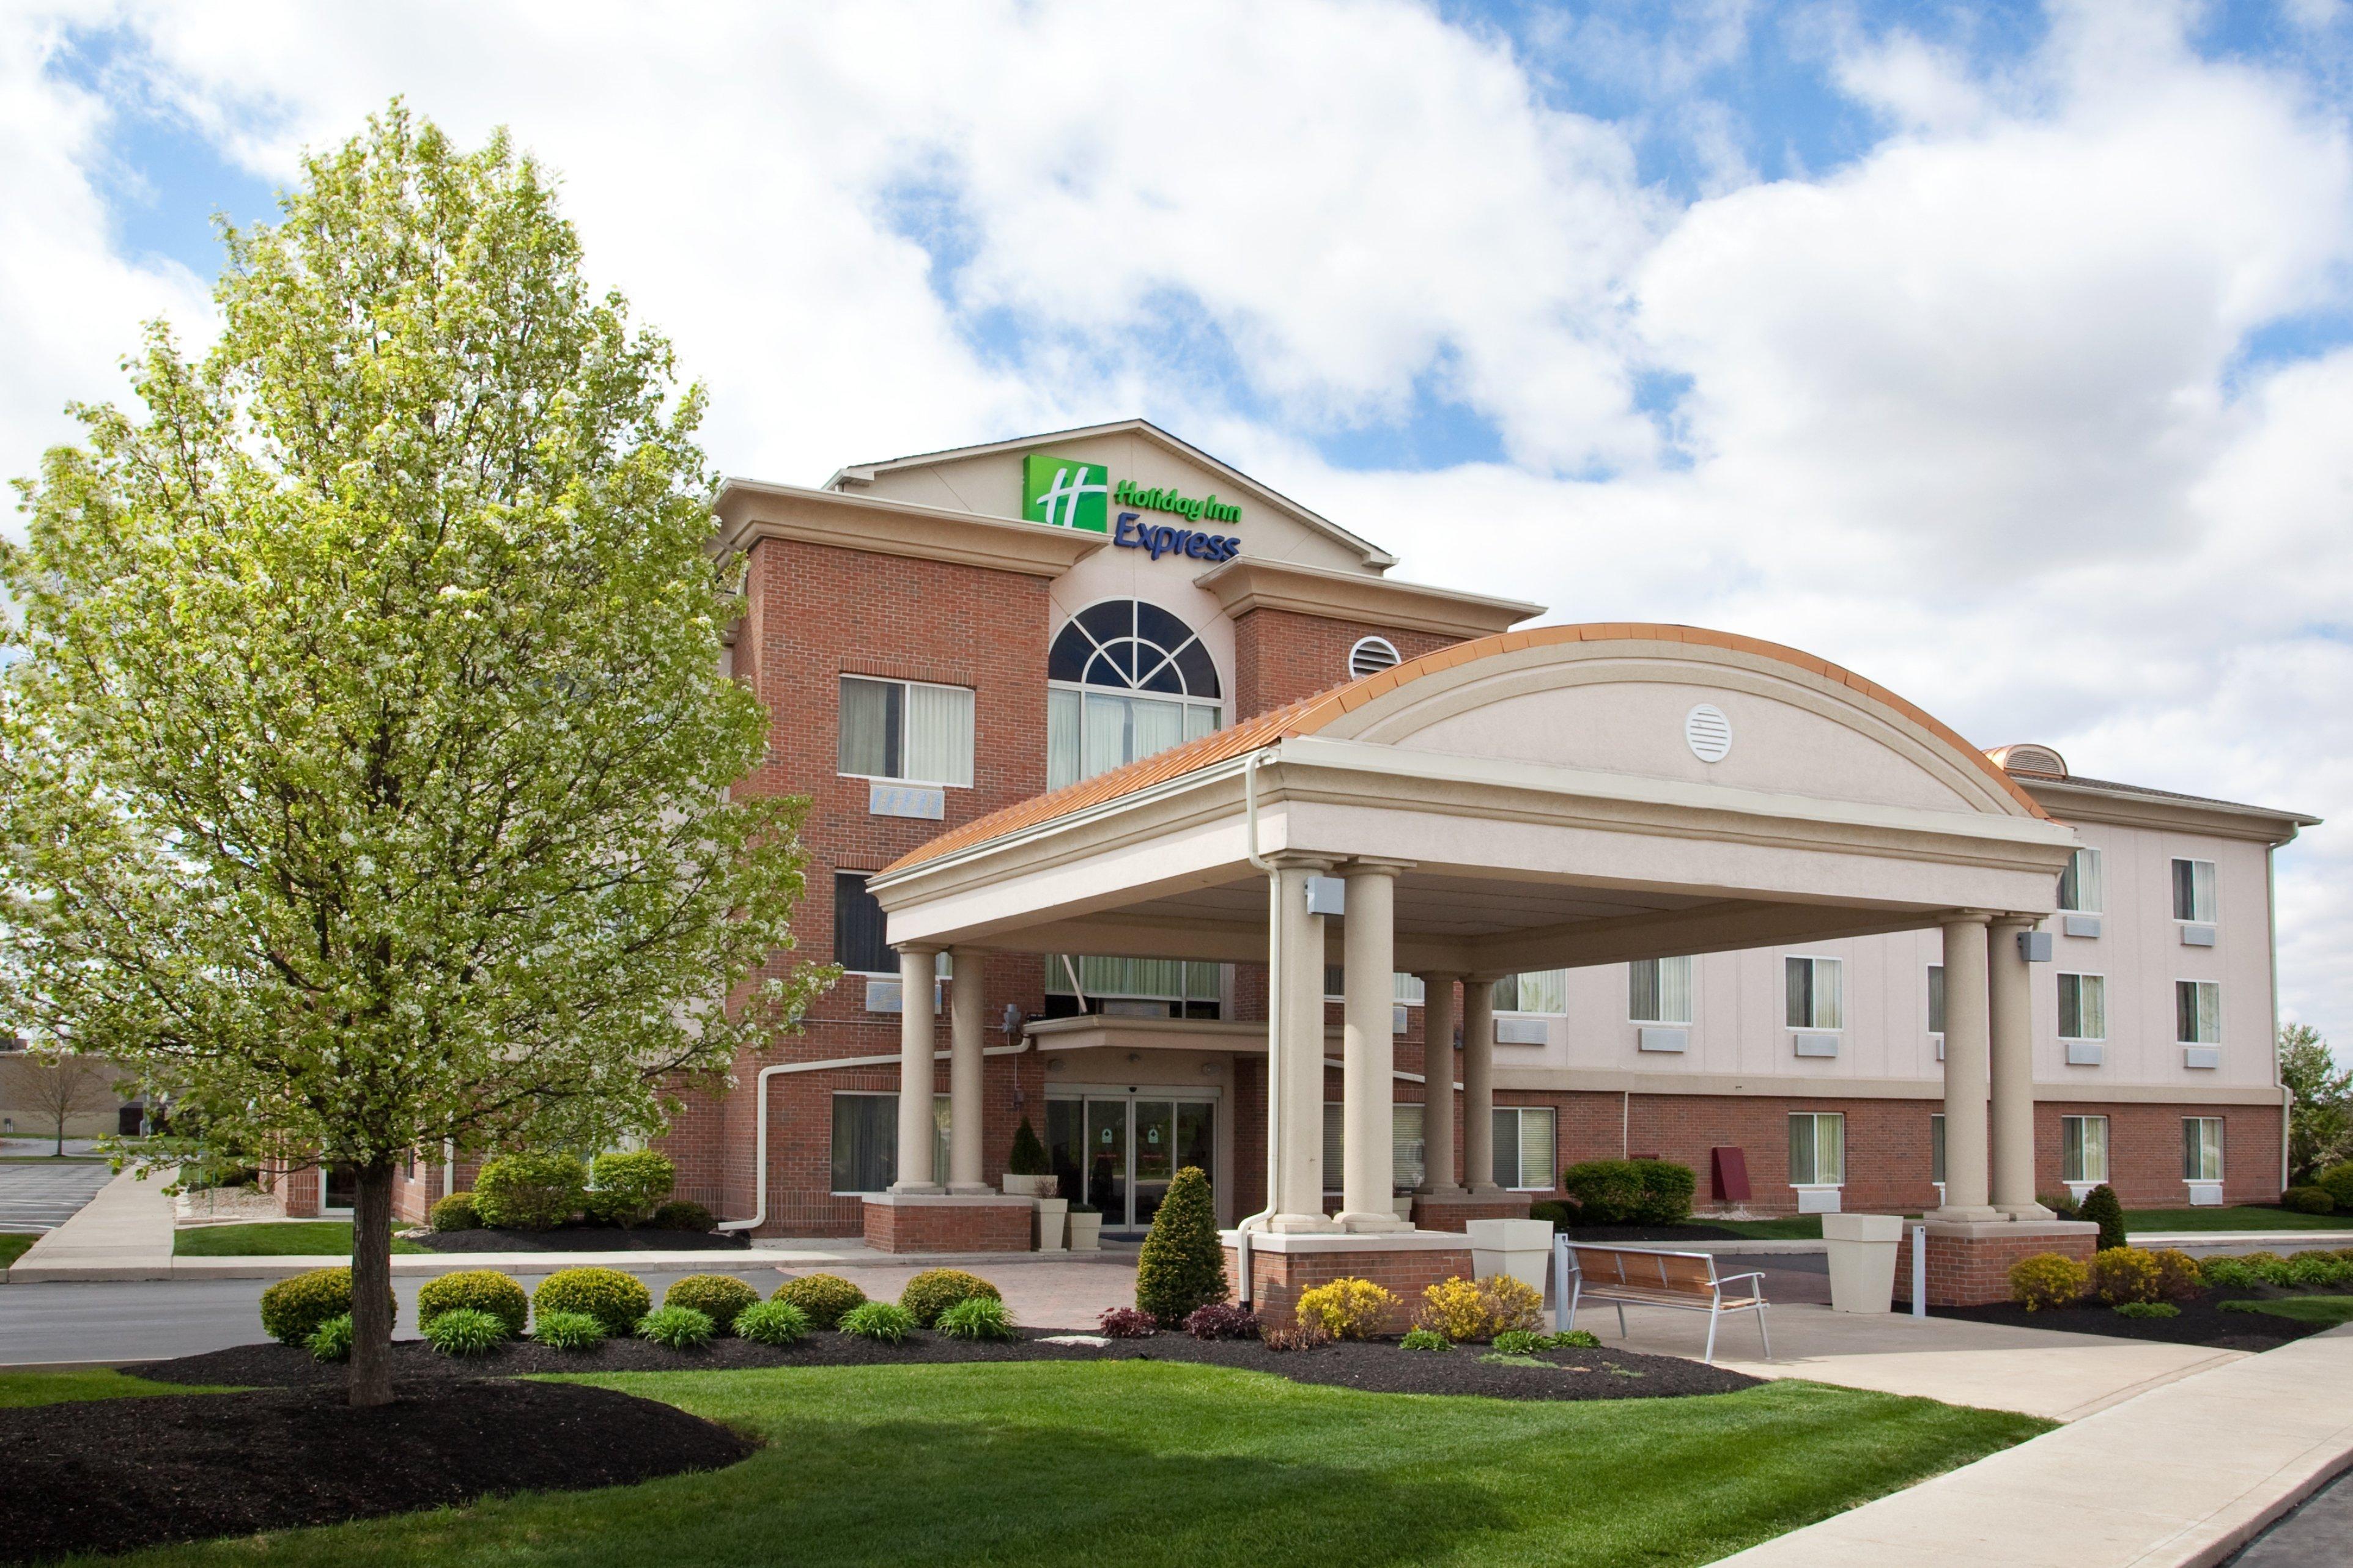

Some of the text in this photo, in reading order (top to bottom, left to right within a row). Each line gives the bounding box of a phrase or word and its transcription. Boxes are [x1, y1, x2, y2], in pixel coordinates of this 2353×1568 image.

[1036, 466, 1107, 528] H
[1115, 479, 1242, 523] Holiday Inn
[1114, 512, 1241, 562] Express
